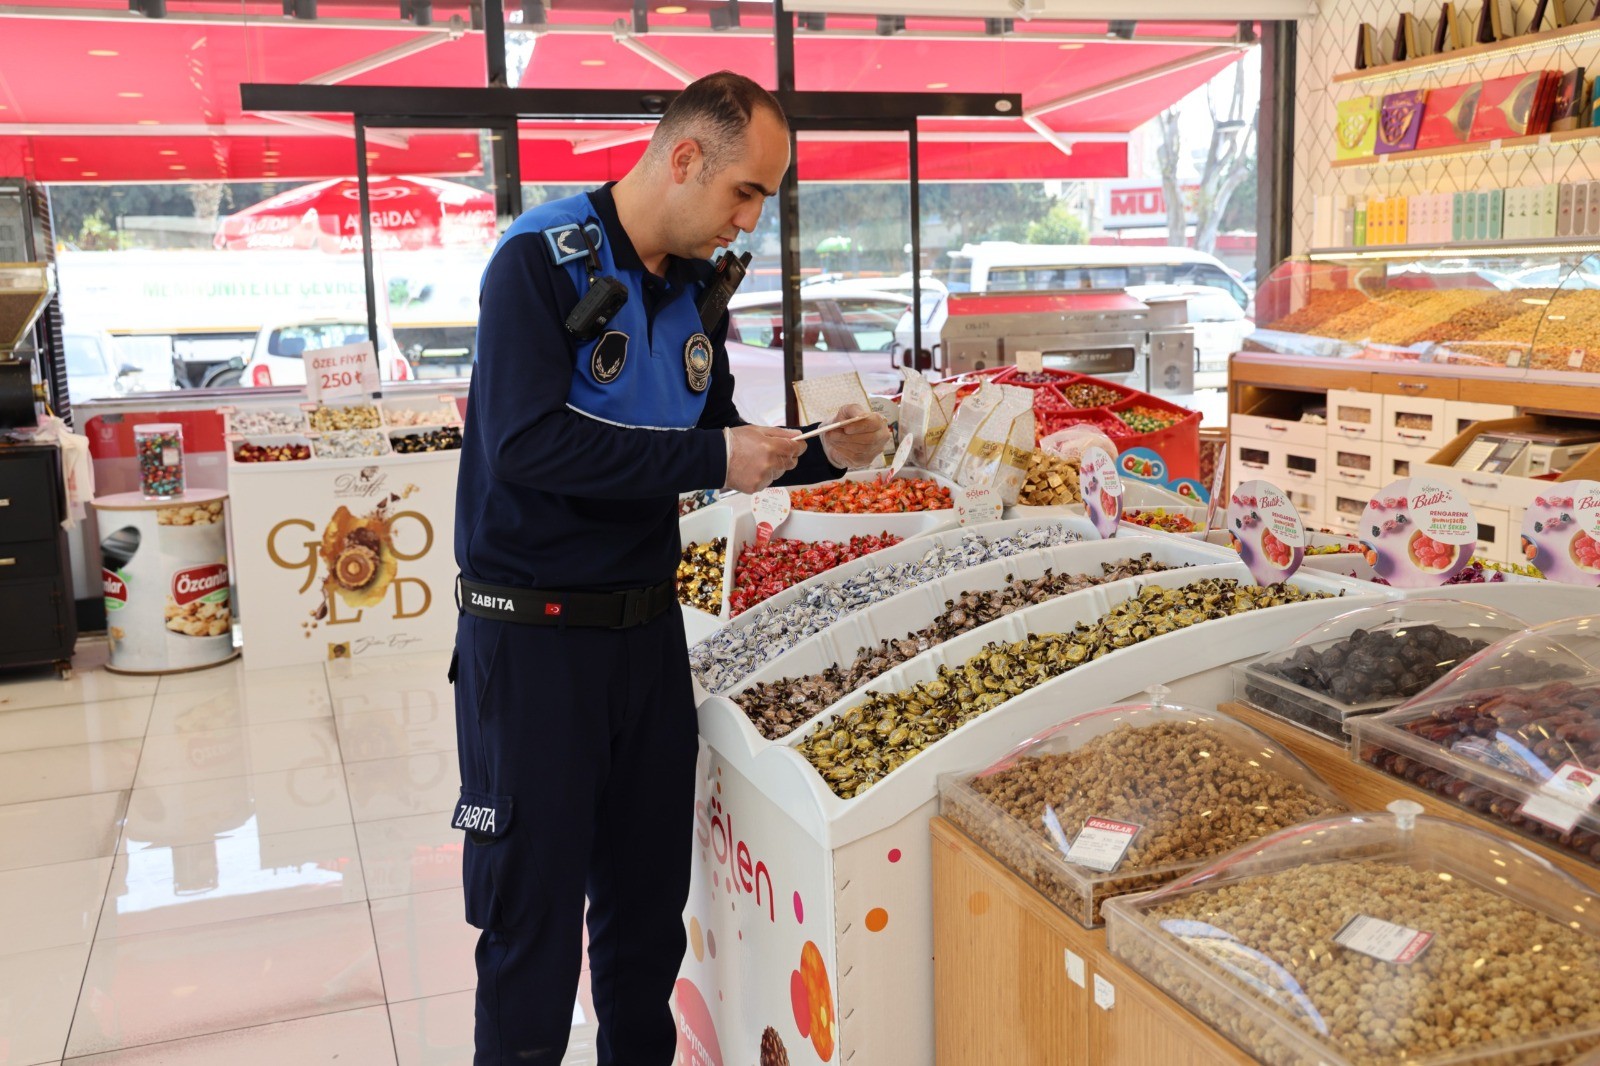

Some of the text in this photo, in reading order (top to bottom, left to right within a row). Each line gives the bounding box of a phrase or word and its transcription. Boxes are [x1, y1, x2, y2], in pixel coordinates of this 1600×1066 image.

[312, 353, 367, 369] ÖZEL FİYAT
[321, 371, 352, 389] 250
[1412, 491, 1446, 509] Butik
[1429, 510, 1469, 518] RENGARENK
[471, 592, 515, 611] ZABITA
[455, 804, 496, 833] ZABITA
